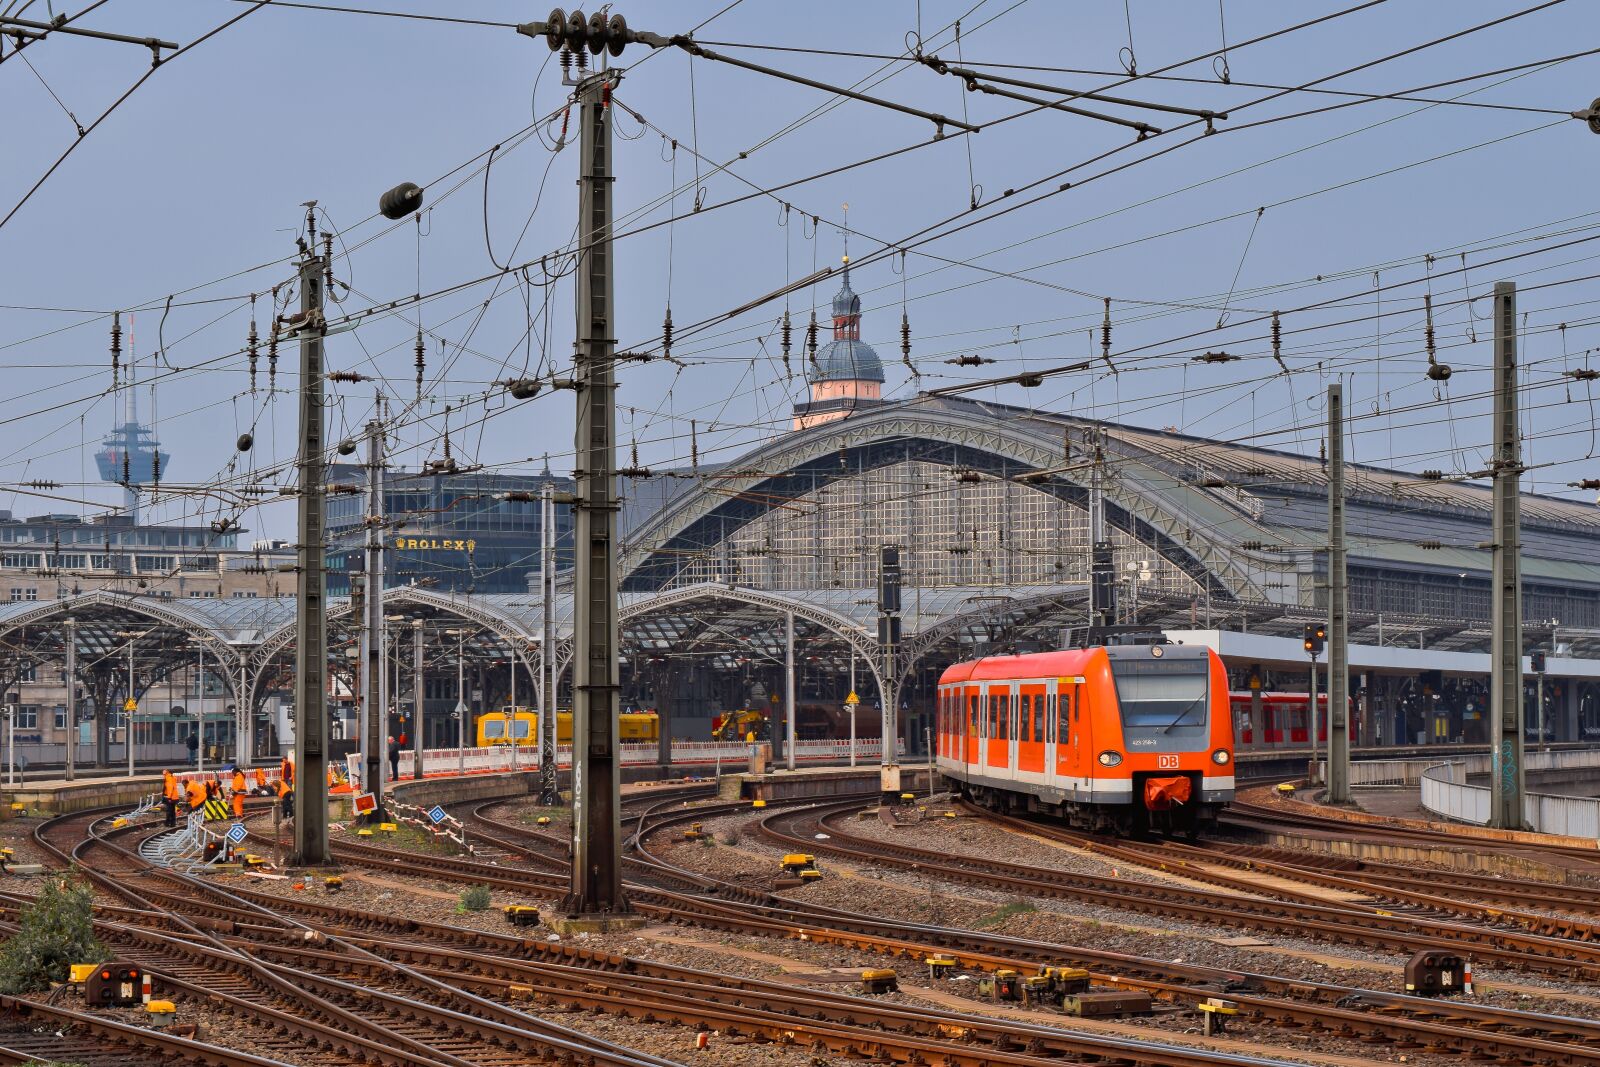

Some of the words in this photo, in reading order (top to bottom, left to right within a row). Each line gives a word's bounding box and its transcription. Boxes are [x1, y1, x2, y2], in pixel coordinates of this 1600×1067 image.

[407, 539, 464, 550] ROLEX
[625, 706, 632, 714] A
[1159, 755, 1178, 768] DB
